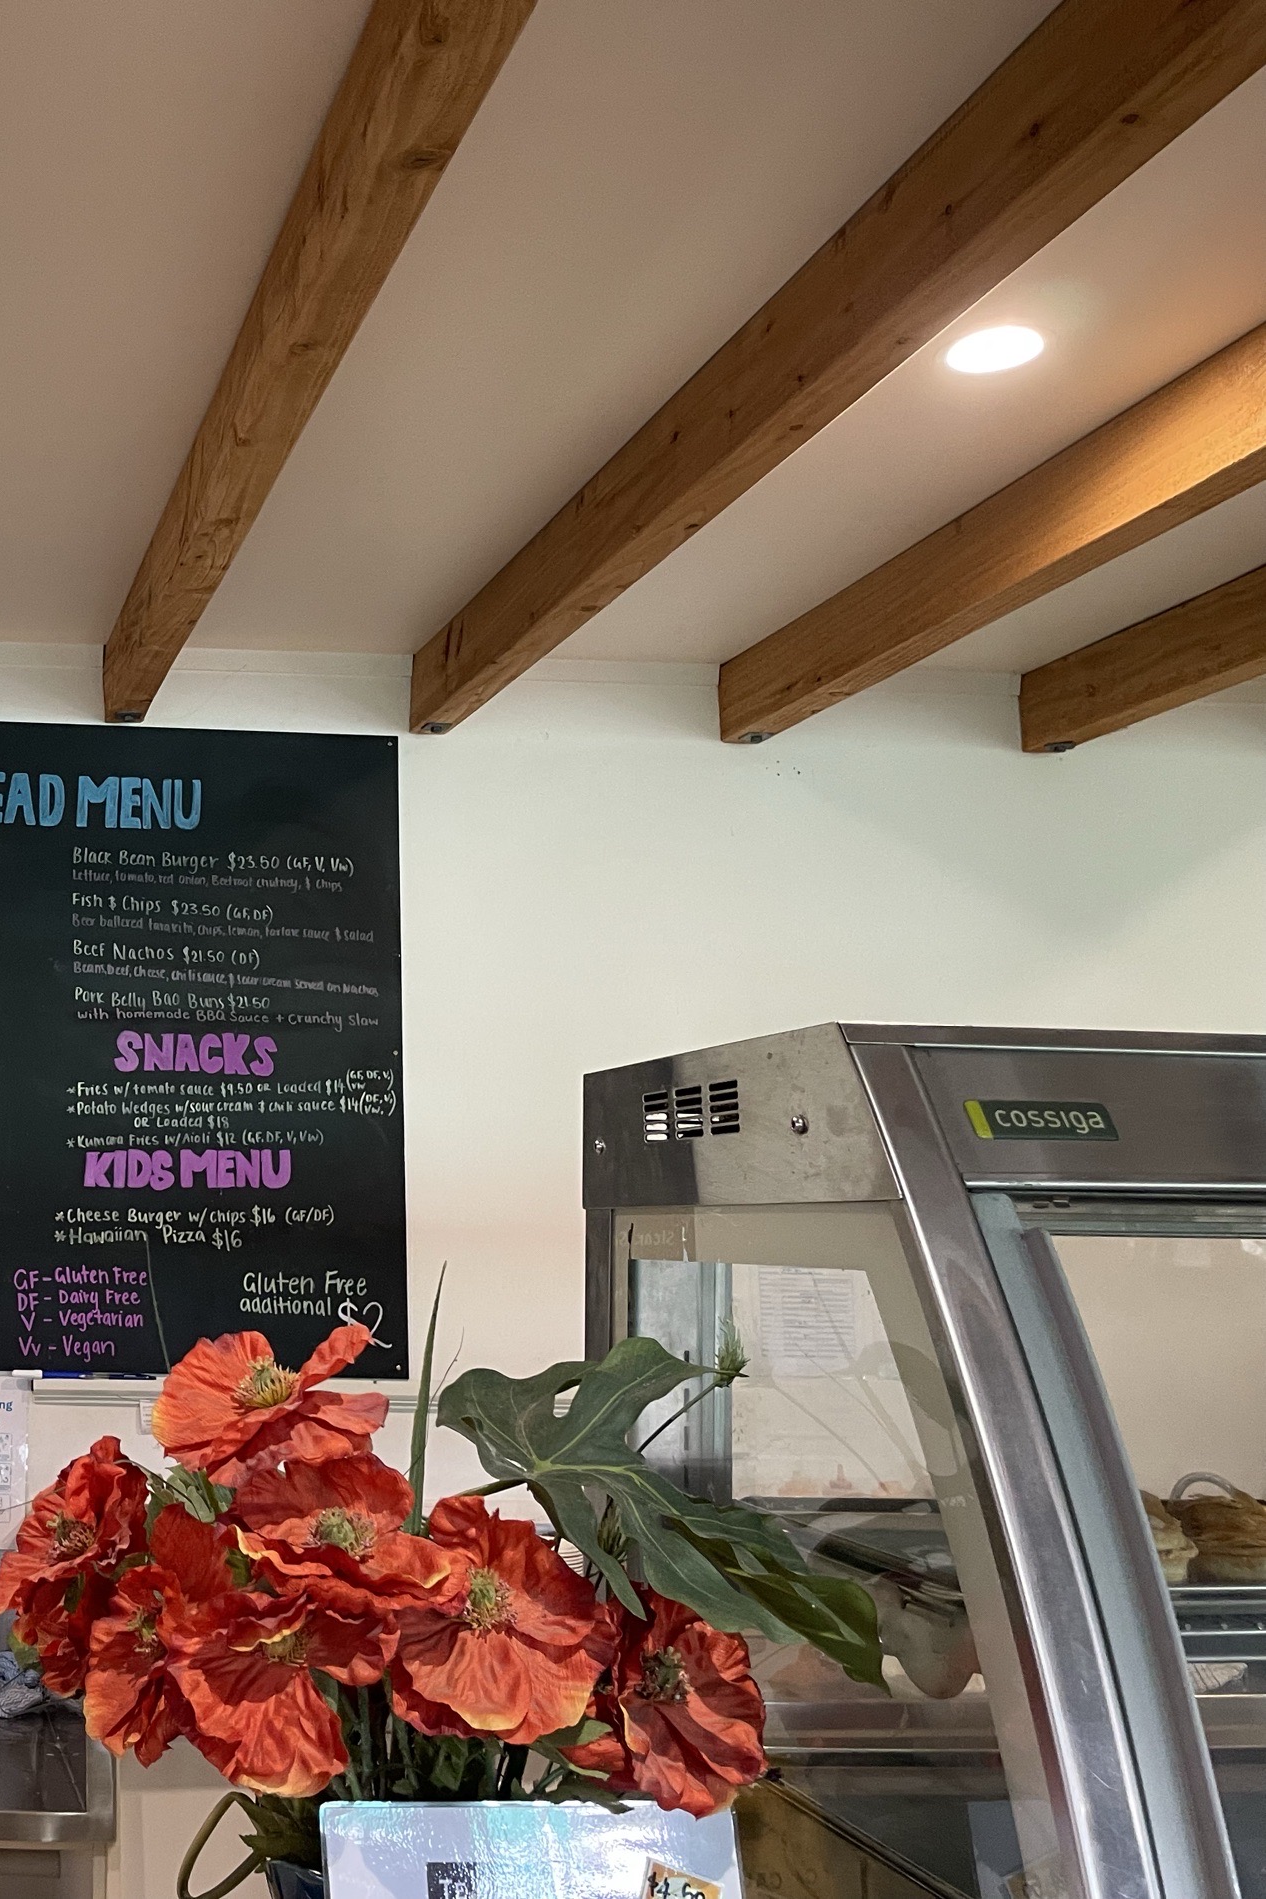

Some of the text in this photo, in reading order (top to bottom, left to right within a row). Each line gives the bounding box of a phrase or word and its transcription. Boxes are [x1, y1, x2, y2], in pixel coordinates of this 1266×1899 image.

[76, 776, 201, 829] MENU
[73, 940, 105, 957] Beef
[113, 943, 174, 960] Nachos
[75, 987, 105, 1004] Pork
[111, 991, 145, 1010] Belly
[152, 991, 179, 1006] Bao
[188, 994, 224, 1009] Buns
[77, 1009, 109, 1020] with
[116, 1008, 190, 1020] homemade
[113, 1030, 278, 1077] SNACKS
[993, 1109, 1105, 1134] cossiga
[83, 1149, 292, 1190] KIDS MENU
[127, 1209, 181, 1228] Burger
[250, 1209, 275, 1225] $16
[163, 1226, 206, 1244] Pizza
[212, 1229, 242, 1251] $16
[115, 1267, 148, 1286] Free
[243, 1271, 367, 1296] Gluten Free
[18, 1293, 38, 1312] DF
[59, 1290, 99, 1310] Dairy
[106, 1290, 141, 1305] Free
[240, 1296, 331, 1316] additional
[20, 1312, 36, 1331] V
[59, 1309, 143, 1329] Vegetarian
[61, 1336, 114, 1362] Vegan
